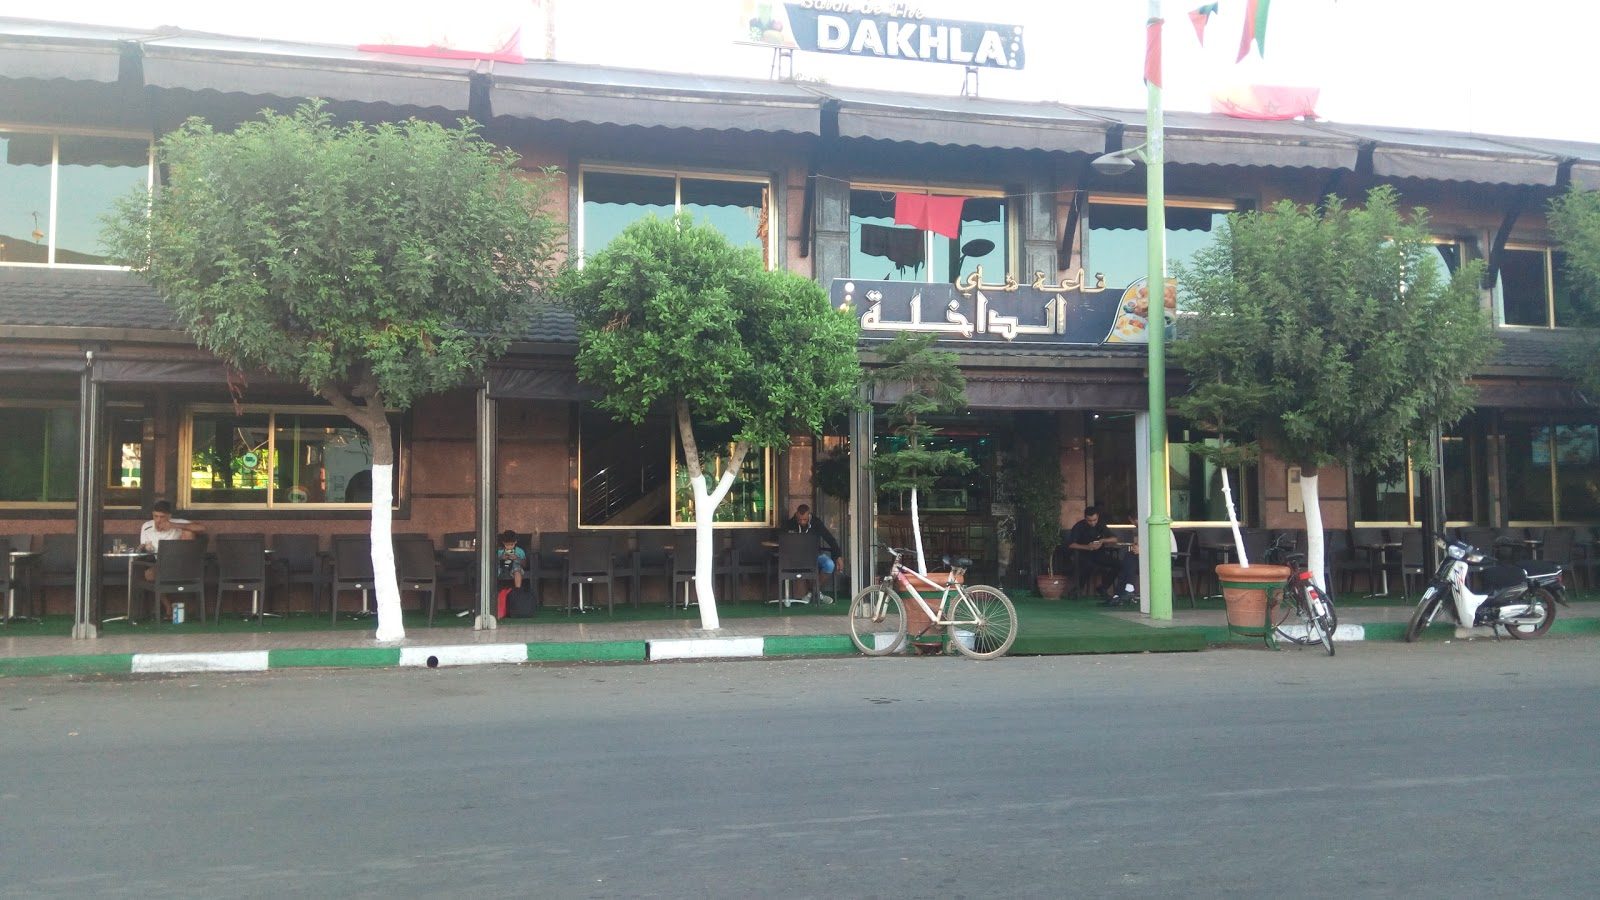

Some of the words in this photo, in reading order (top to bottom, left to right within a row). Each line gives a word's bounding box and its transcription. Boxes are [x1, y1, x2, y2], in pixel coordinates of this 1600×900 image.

[818, 14, 1008, 66] DAKHLA
[955, 264, 1019, 297] شاي
[1032, 267, 1106, 293] قاعة
[861, 289, 1068, 341] الداخلة
